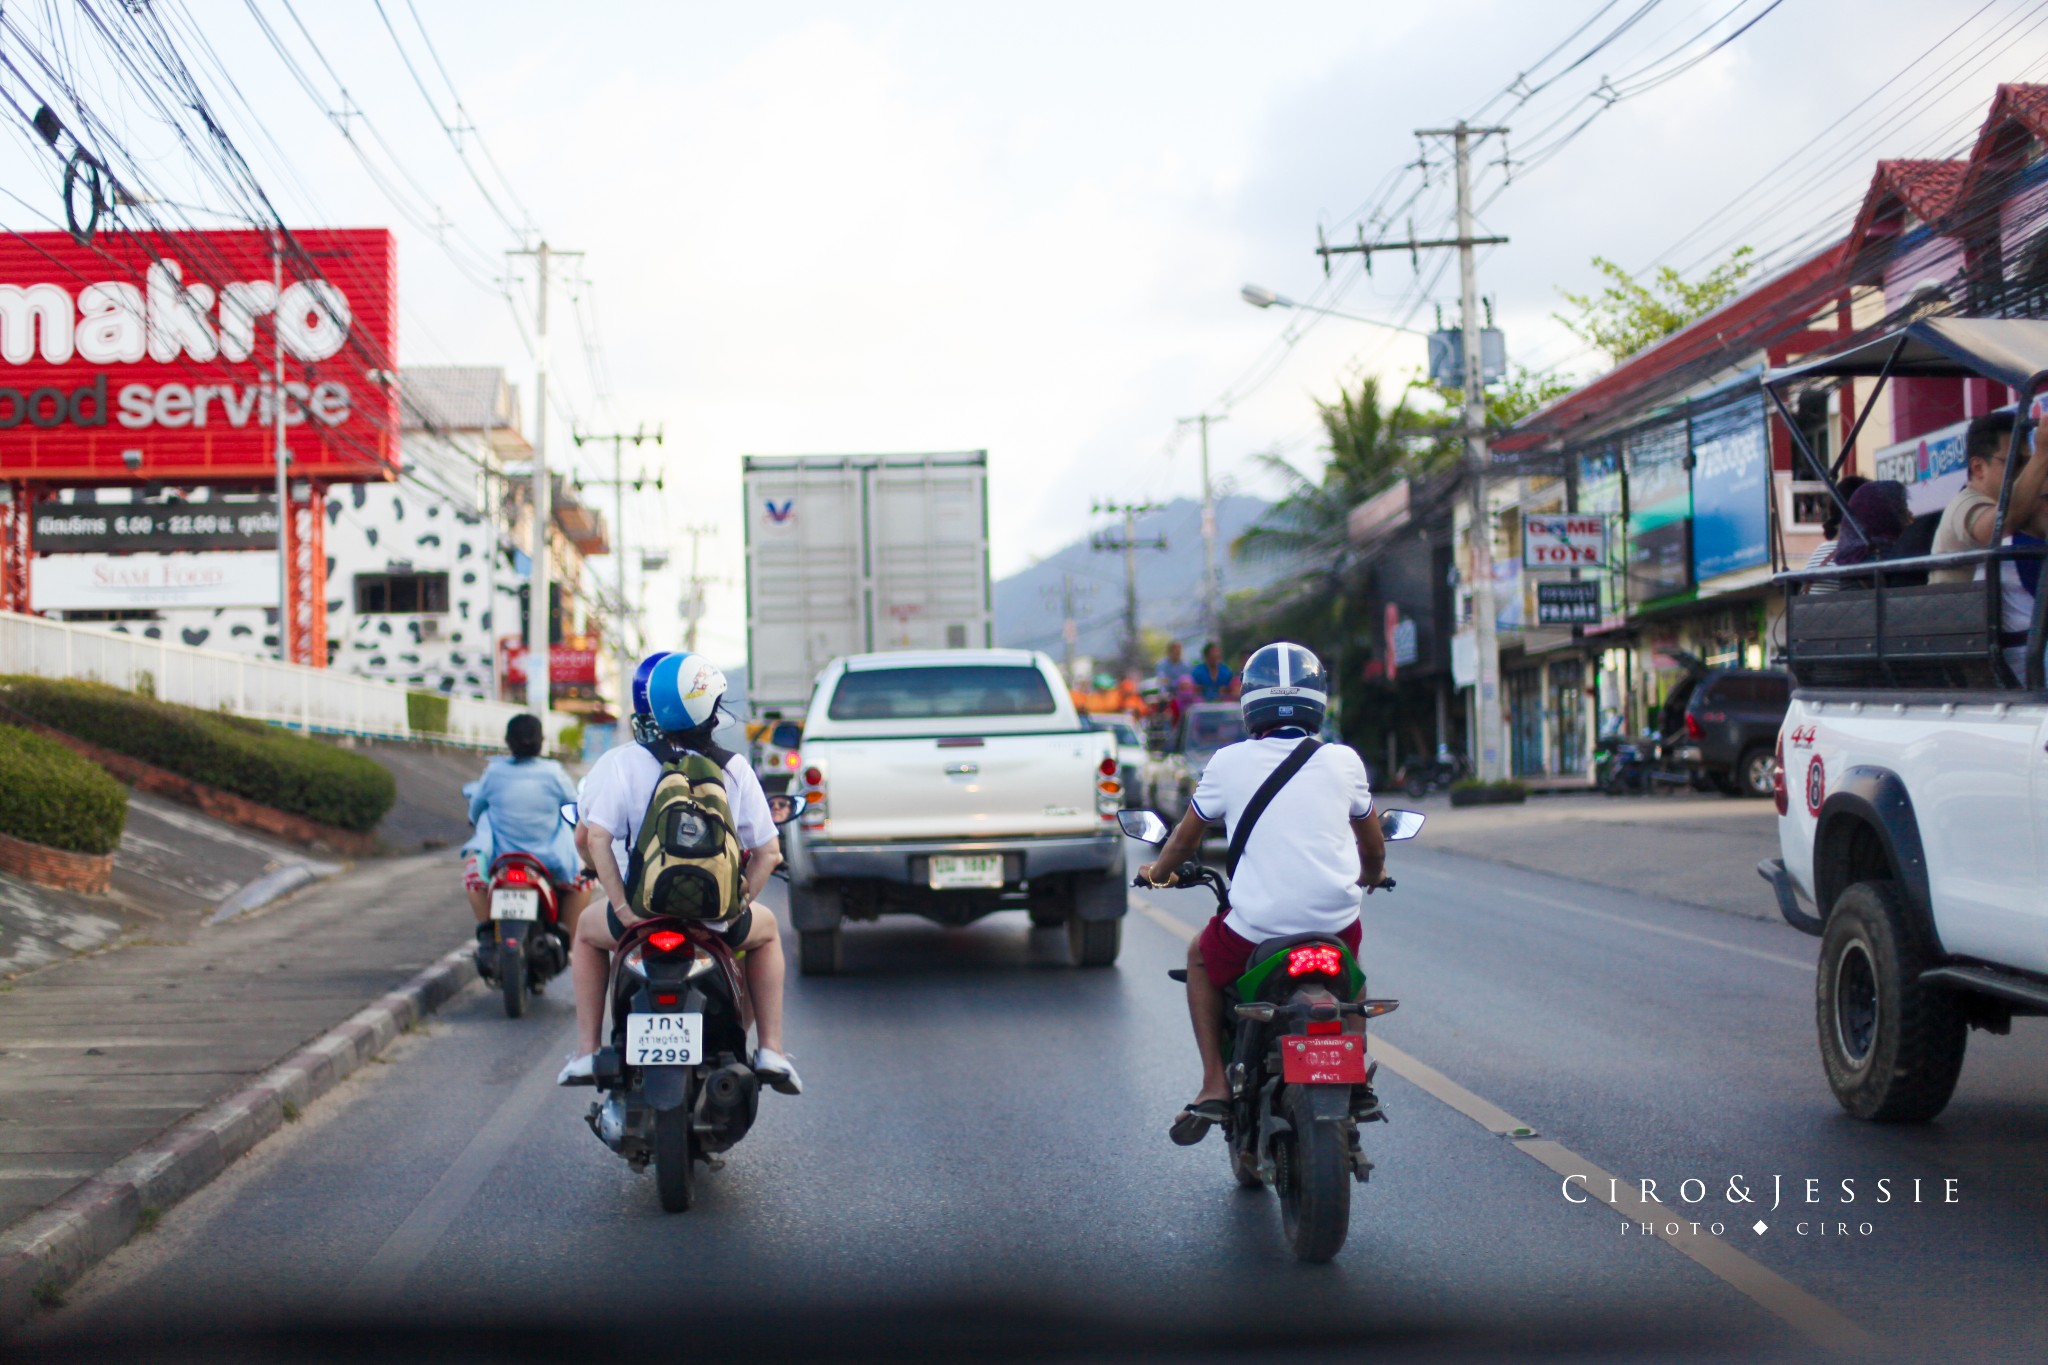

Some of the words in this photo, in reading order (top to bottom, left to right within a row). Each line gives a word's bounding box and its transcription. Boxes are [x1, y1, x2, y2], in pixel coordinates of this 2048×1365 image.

[0, 258, 352, 365] makro
[116, 371, 351, 429] service
[1929, 431, 1967, 480] Desig
[1534, 546, 1597, 563] TOYS
[1541, 603, 1596, 618] FRAME
[638, 1049, 690, 1063] 7299
